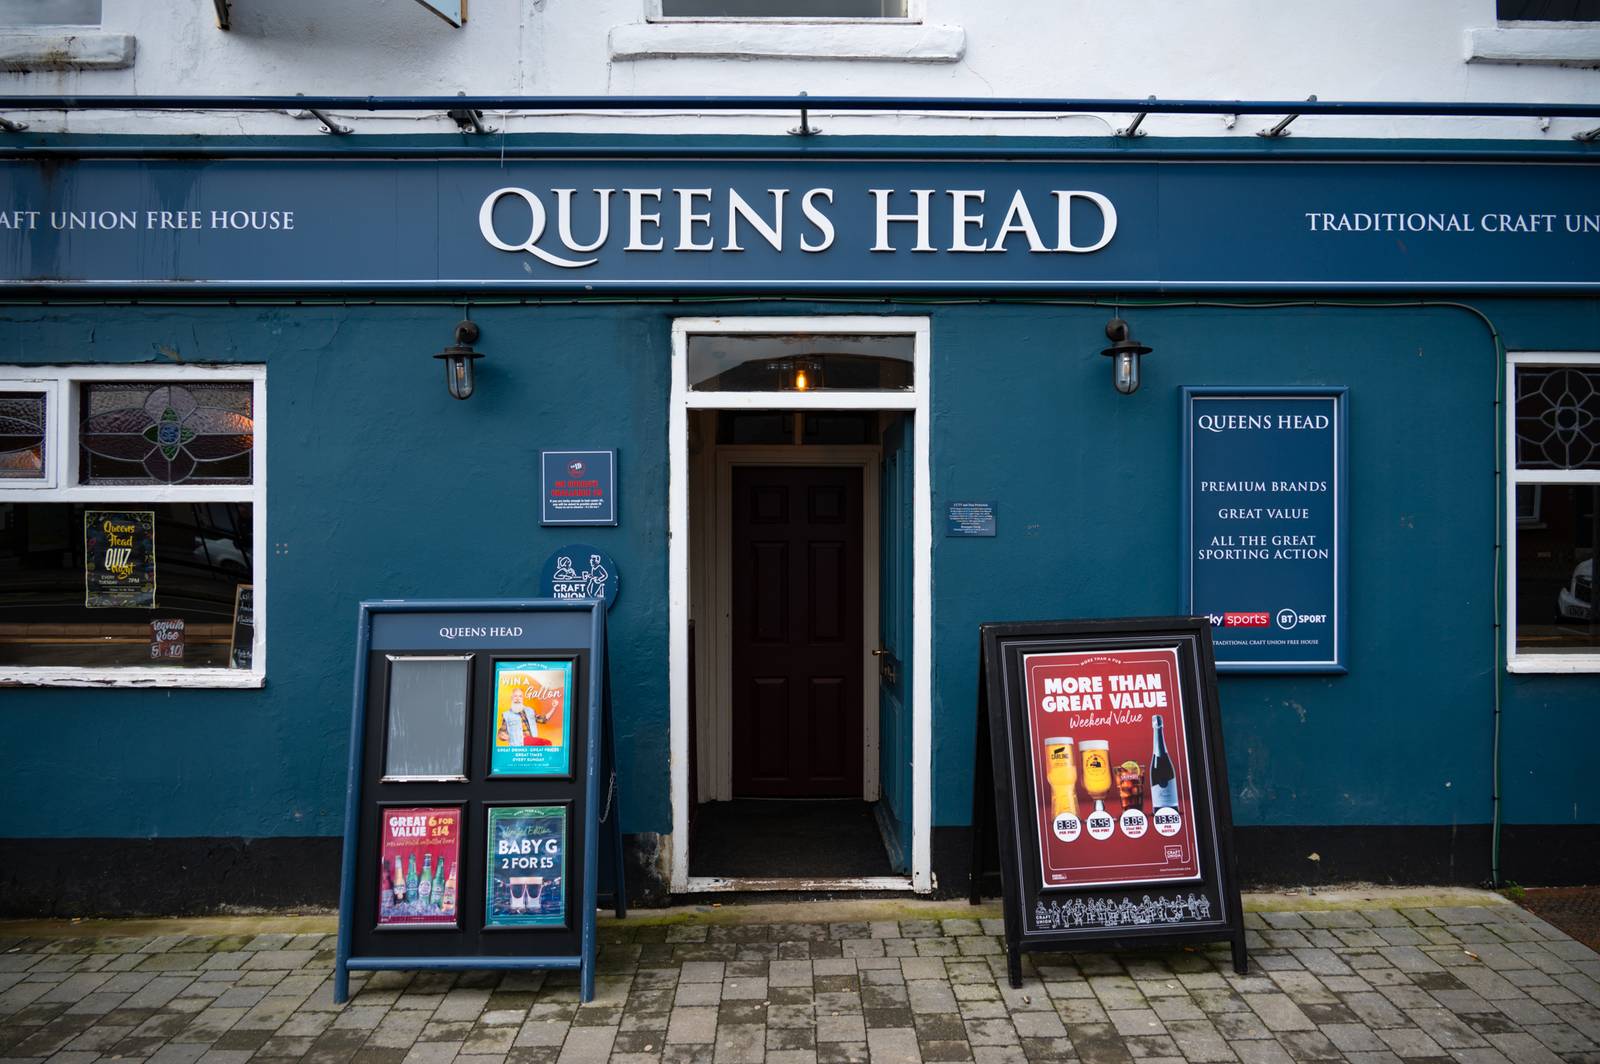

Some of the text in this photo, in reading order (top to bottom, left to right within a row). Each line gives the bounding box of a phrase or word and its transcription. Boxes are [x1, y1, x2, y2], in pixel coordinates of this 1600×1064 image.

[51, 211, 137, 230] UNION
[146, 211, 202, 229] FREE
[211, 211, 294, 230] HOUSE
[1305, 212, 1474, 232] TRADITIONAL
[1481, 213, 1556, 233] CRAFT
[479, 187, 1118, 268] QUEENS HEAD
[1198, 414, 1329, 433] QUEENS HEAD
[1201, 481, 1327, 492] PREMIUM BRANDS
[1218, 508, 1309, 519] GREAT VALUE
[1211, 535, 1316, 546] ALL THE GREAT
[105, 548, 132, 570] QUIZ
[1198, 549, 1329, 560] SPORTING ACTION
[553, 584, 586, 592] CRAFT
[1227, 614, 1267, 626] sports
[1281, 614, 1327, 624] BT SPORT
[439, 627, 523, 639] QUEENS HEAD
[1044, 673, 1162, 695] MORE THAN
[525, 685, 562, 700] Gallon
[1042, 691, 1168, 713] GREAT VALUE
[1069, 709, 1143, 729] Weekend Value
[389, 816, 427, 827] GREAT
[428, 816, 454, 827] 6 FOR
[391, 826, 427, 837] VALUE
[498, 838, 558, 855] BABY G
[502, 857, 554, 869] 2 FOR £5
